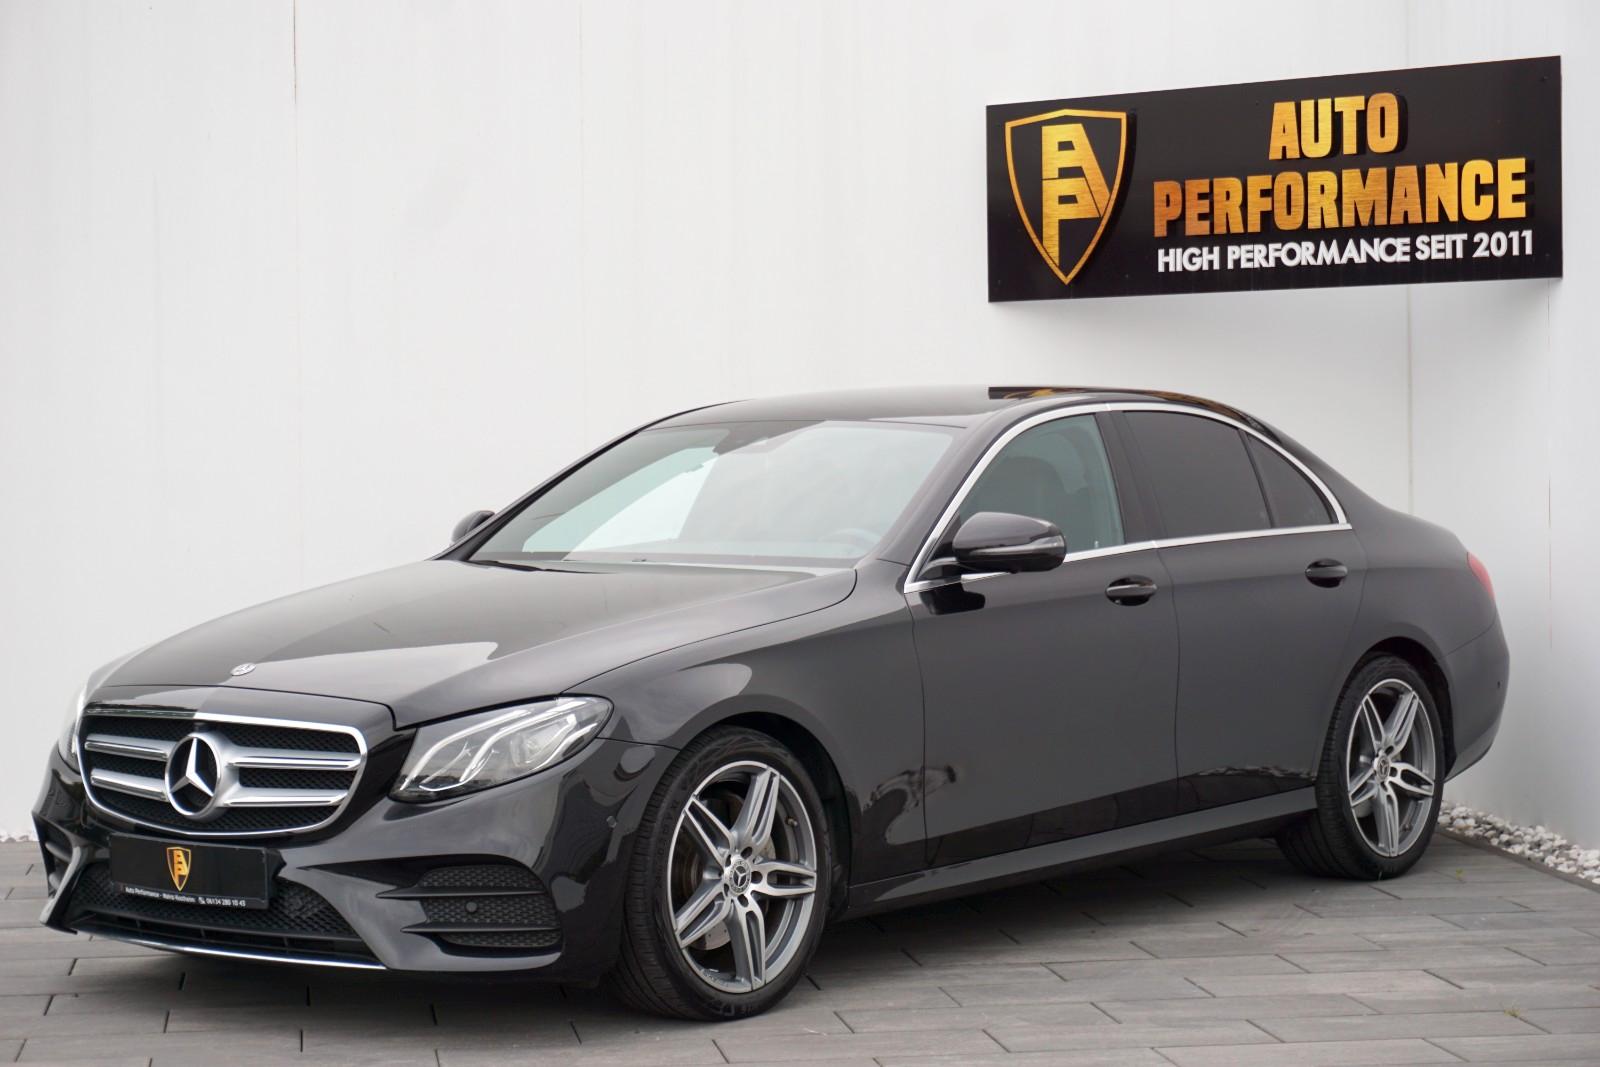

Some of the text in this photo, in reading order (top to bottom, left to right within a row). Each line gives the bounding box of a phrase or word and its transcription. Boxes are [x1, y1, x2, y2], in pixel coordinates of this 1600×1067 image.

[1269, 93, 1398, 160] AUTO
[1154, 157, 1526, 237] PERFORMANCE
[1158, 230, 1533, 272] HIGH PERFORMANCE SEIT 2011
